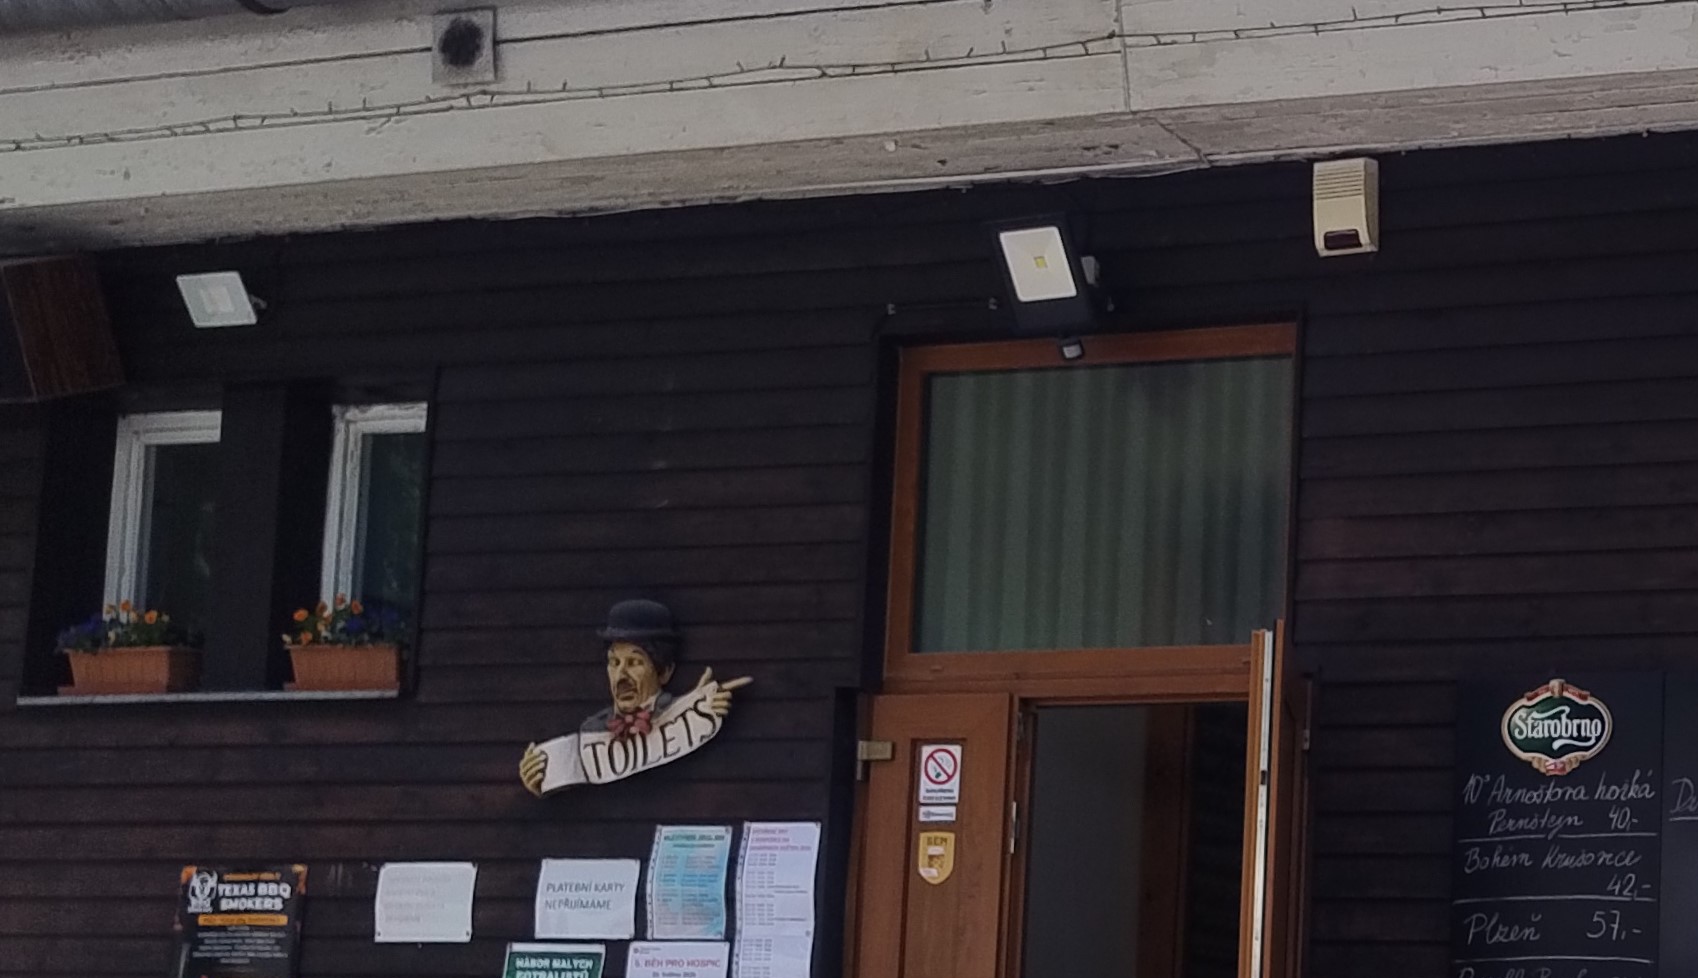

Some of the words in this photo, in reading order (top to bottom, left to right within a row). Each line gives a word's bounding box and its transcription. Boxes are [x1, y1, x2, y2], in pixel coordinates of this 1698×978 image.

[583, 697, 718, 779] TOILETS
[1513, 705, 1602, 750] Starobrno
[1488, 807, 1584, 840] Pernštejn
[218, 883, 256, 897] TEXAS
[257, 882, 292, 899] BBQ
[546, 882, 593, 893] PLATEBNÍ
[594, 883, 625, 893] KARTY
[1606, 873, 1652, 898] 42,-
[220, 897, 284, 911] SMOKERS
[1463, 912, 1542, 945] Plzeň
[1586, 909, 1642, 940] 57,-
[515, 956, 550, 969] NÁBOR
[644, 957, 664, 968] BĚH
[665, 959, 684, 968] PRO
[686, 959, 721, 968] HOSPIC
